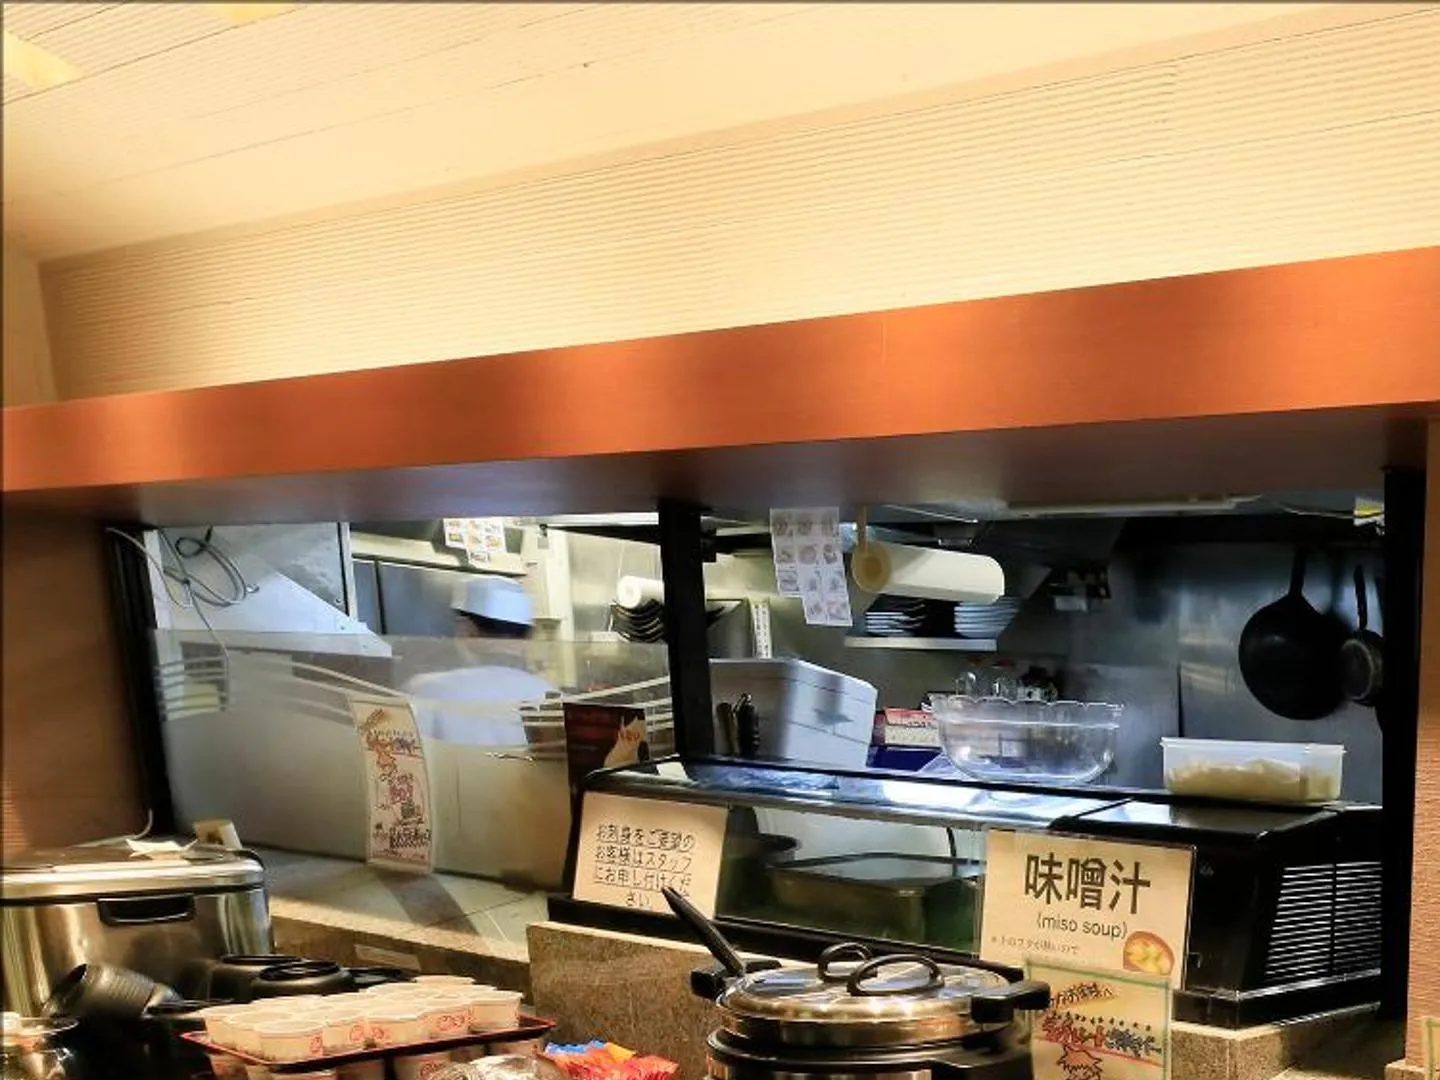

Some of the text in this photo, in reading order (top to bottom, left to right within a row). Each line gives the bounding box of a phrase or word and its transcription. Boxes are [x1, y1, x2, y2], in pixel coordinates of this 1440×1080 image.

[1024, 852, 1151, 915] 味噌汁
[1037, 911, 1128, 939] (miso soup)
